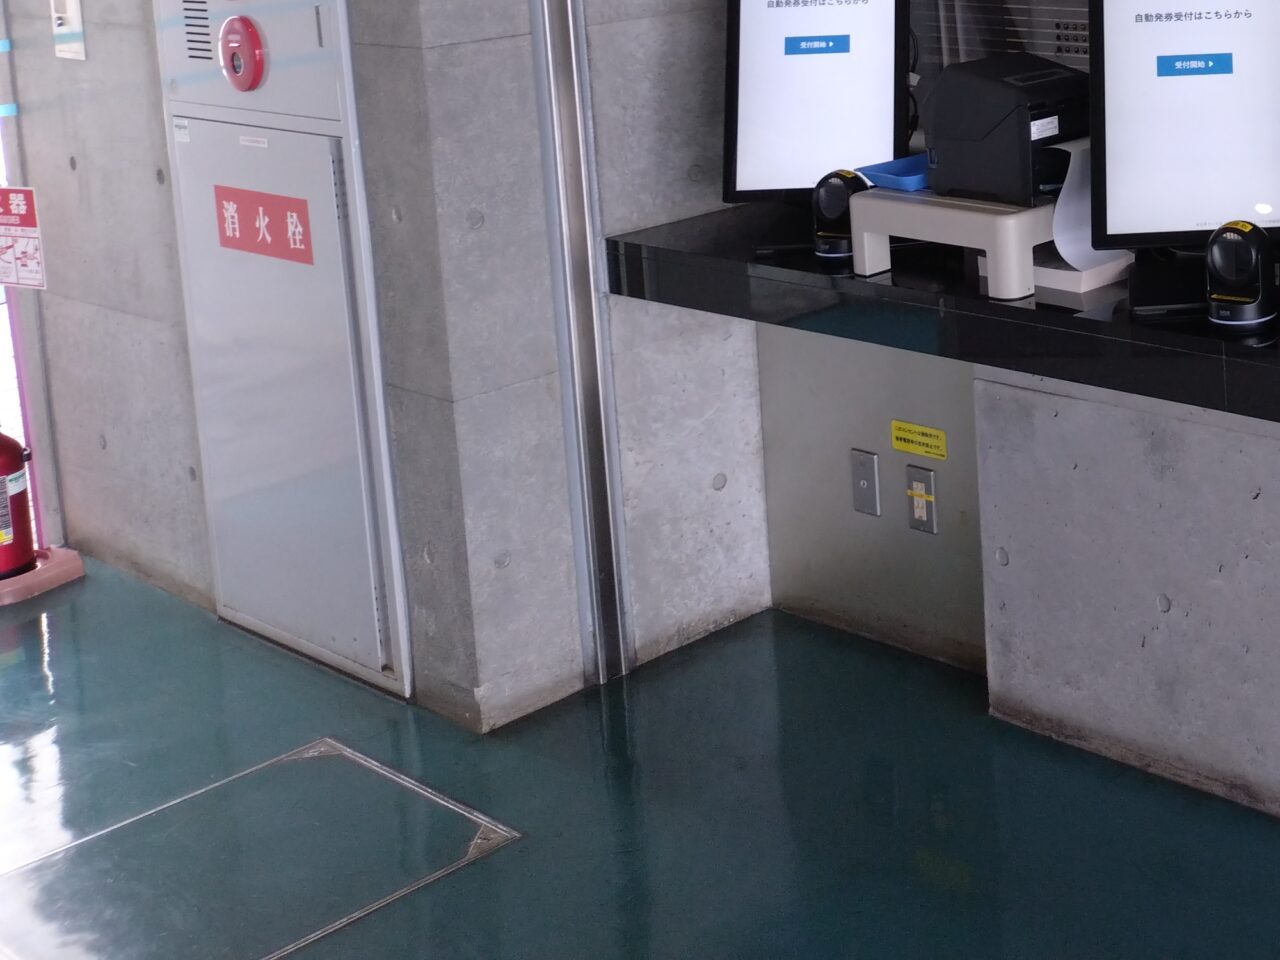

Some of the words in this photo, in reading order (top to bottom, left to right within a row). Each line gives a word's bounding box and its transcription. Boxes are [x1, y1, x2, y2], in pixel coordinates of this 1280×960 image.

[1135, 9, 1252, 23] 自動発券受付はこちらから
[222, 200, 305, 249] 消火栓
